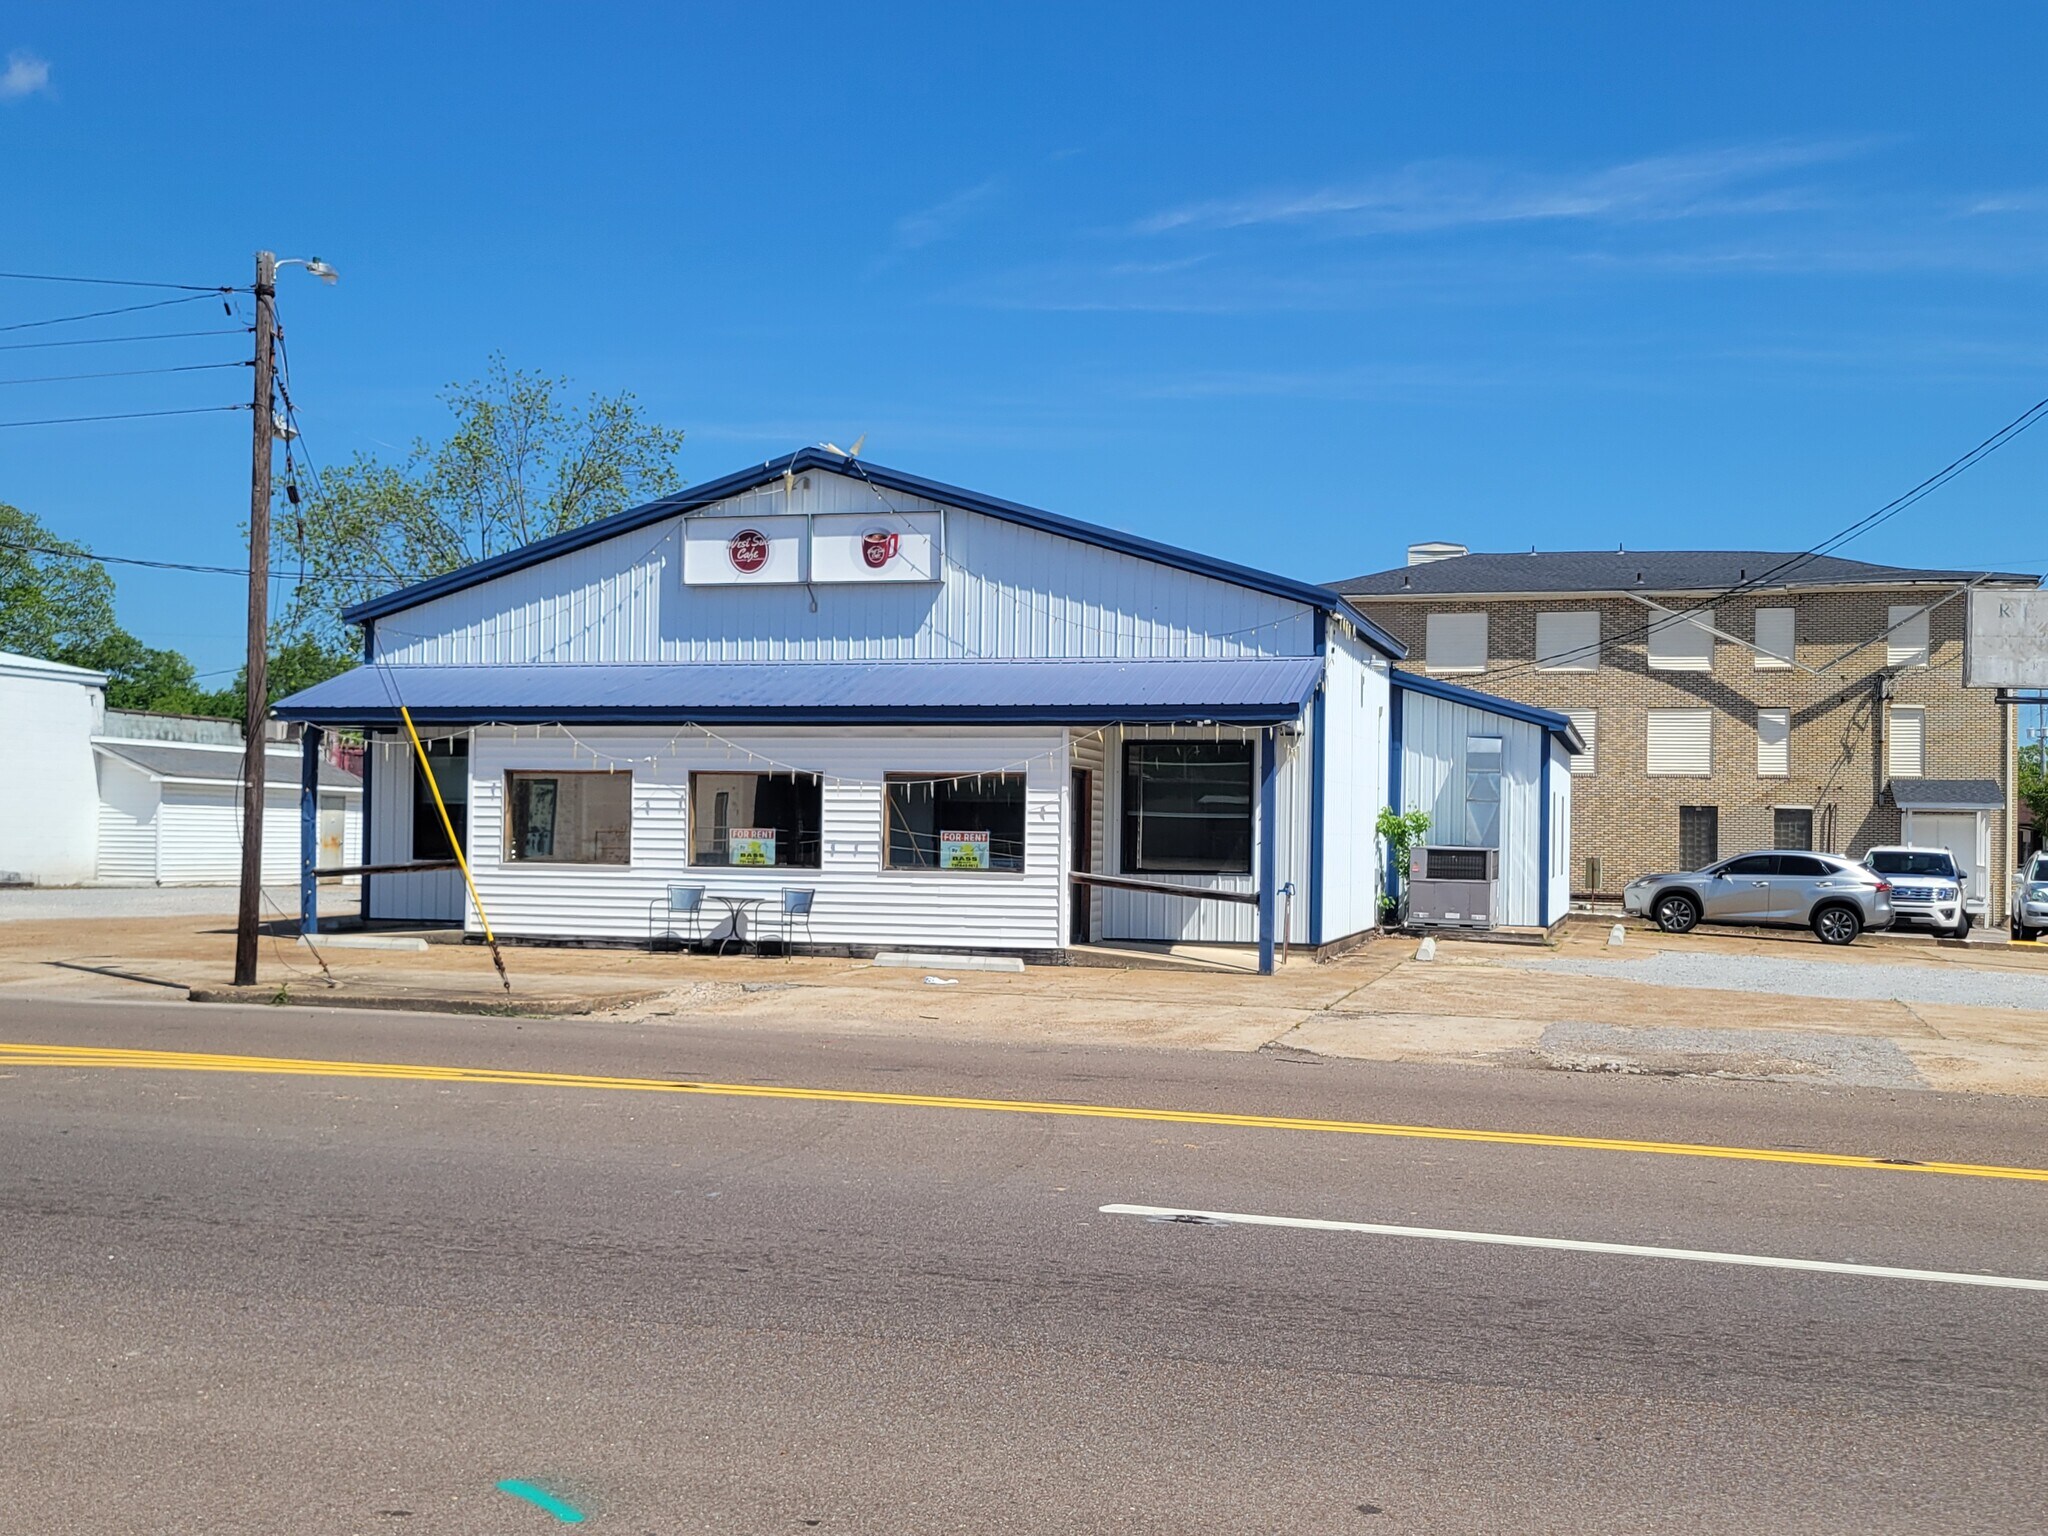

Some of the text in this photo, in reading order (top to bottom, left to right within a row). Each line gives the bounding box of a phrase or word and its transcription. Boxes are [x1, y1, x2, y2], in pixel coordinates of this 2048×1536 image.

[732, 830, 772, 839] FOR RENT
[944, 833, 987, 842] FOR RENT
